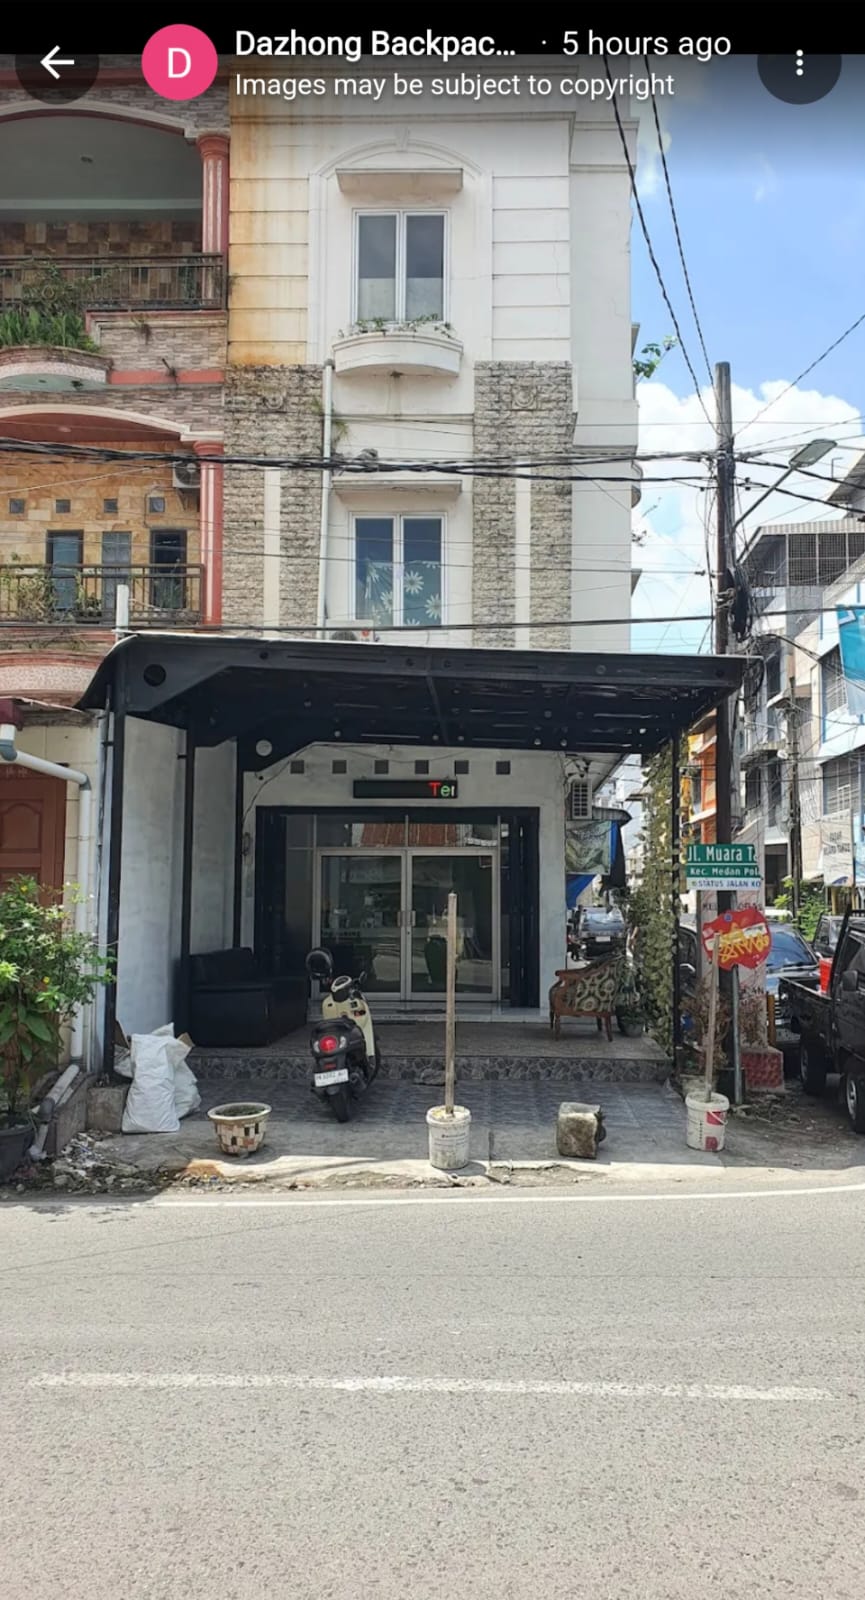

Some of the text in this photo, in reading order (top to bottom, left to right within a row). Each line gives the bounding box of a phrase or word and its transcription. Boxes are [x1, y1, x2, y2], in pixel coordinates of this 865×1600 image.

[687, 846, 701, 862] Jl.
[706, 846, 742, 862] Muara
[690, 867, 708, 876] Kec.
[712, 867, 741, 876] Medan
